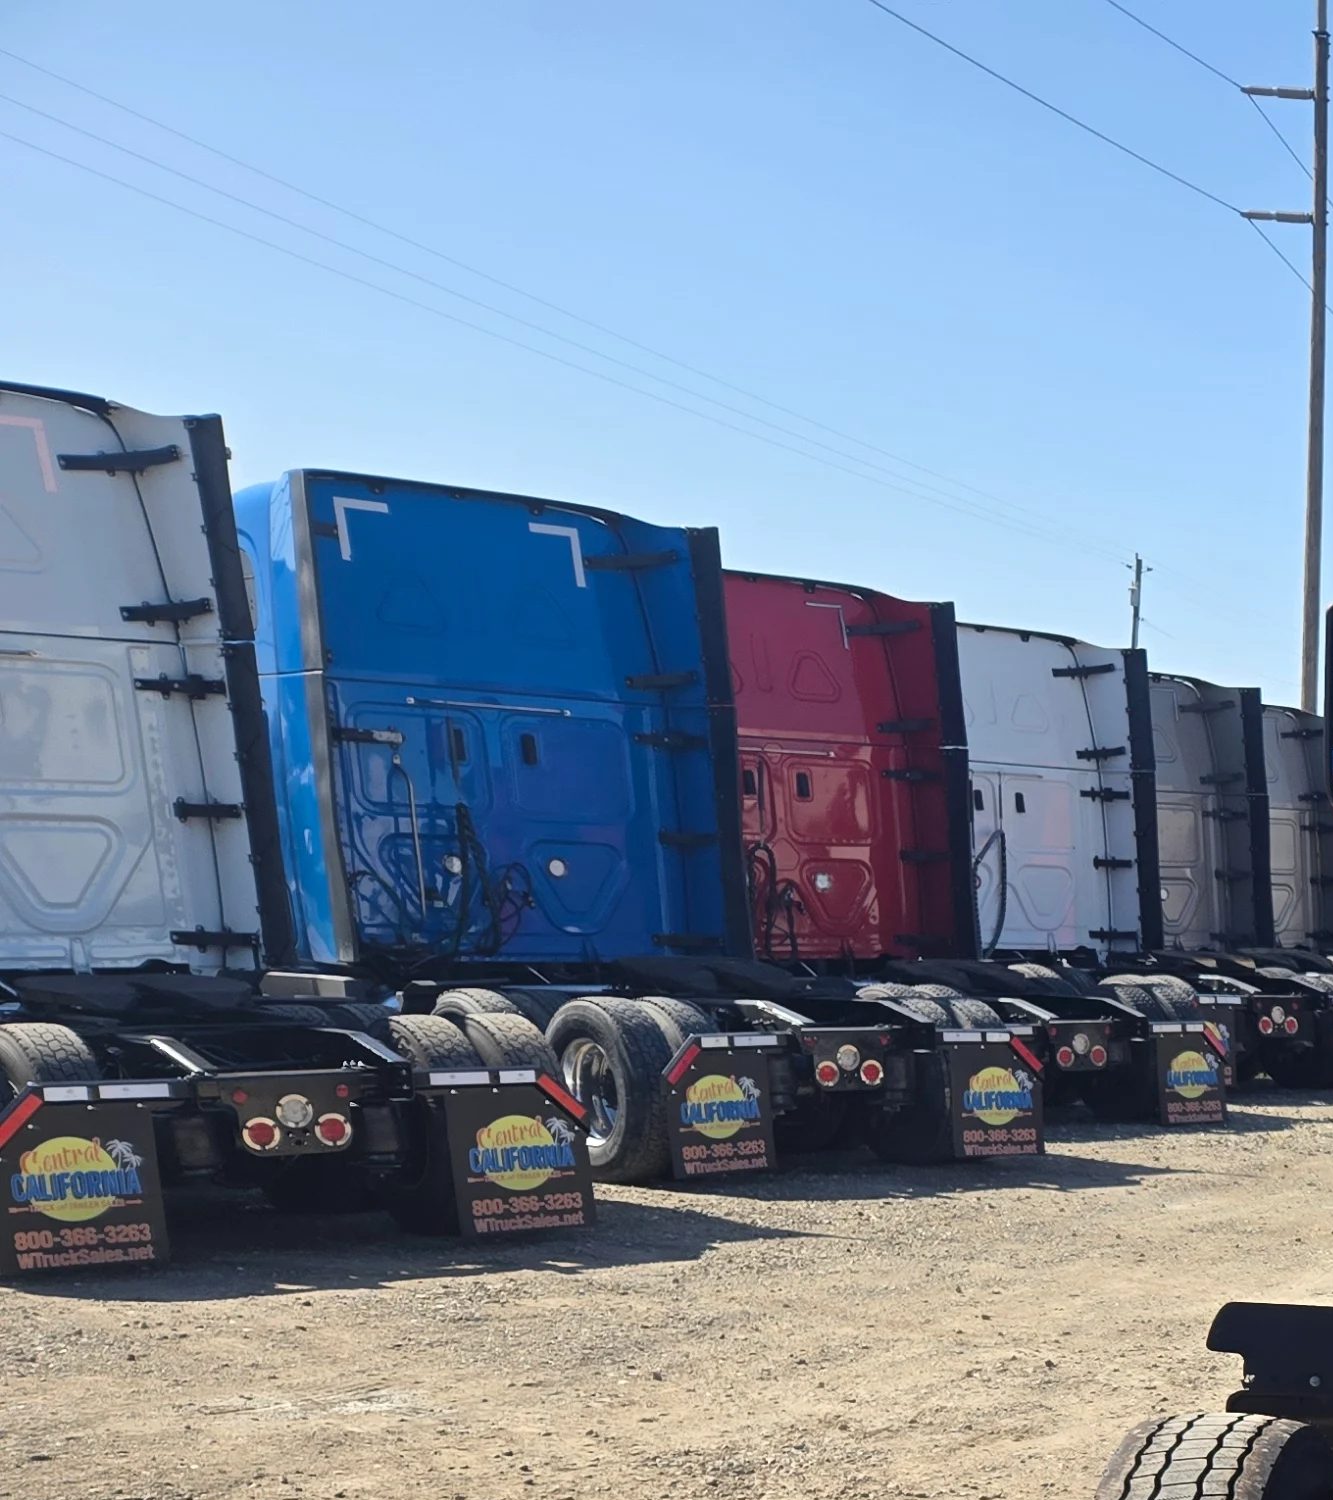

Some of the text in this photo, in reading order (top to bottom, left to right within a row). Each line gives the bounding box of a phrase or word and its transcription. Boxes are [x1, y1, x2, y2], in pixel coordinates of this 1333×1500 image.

[681, 1098, 761, 1125] CALIFORNIA
[476, 1115, 544, 1148] Central
[963, 1128, 1037, 1143] 800-366-3263
[19, 1136, 104, 1175] Central
[469, 1143, 576, 1173] CALIFORNIA
[682, 1139, 766, 1160] 800-366-3263
[10, 1168, 143, 1203] CALIFORNIA
[472, 1192, 583, 1216] 800-366-3263
[473, 1210, 585, 1233] WTruckSales.net
[14, 1223, 152, 1251] 800-366-3263
[16, 1244, 155, 1270] WTruckSales.net
